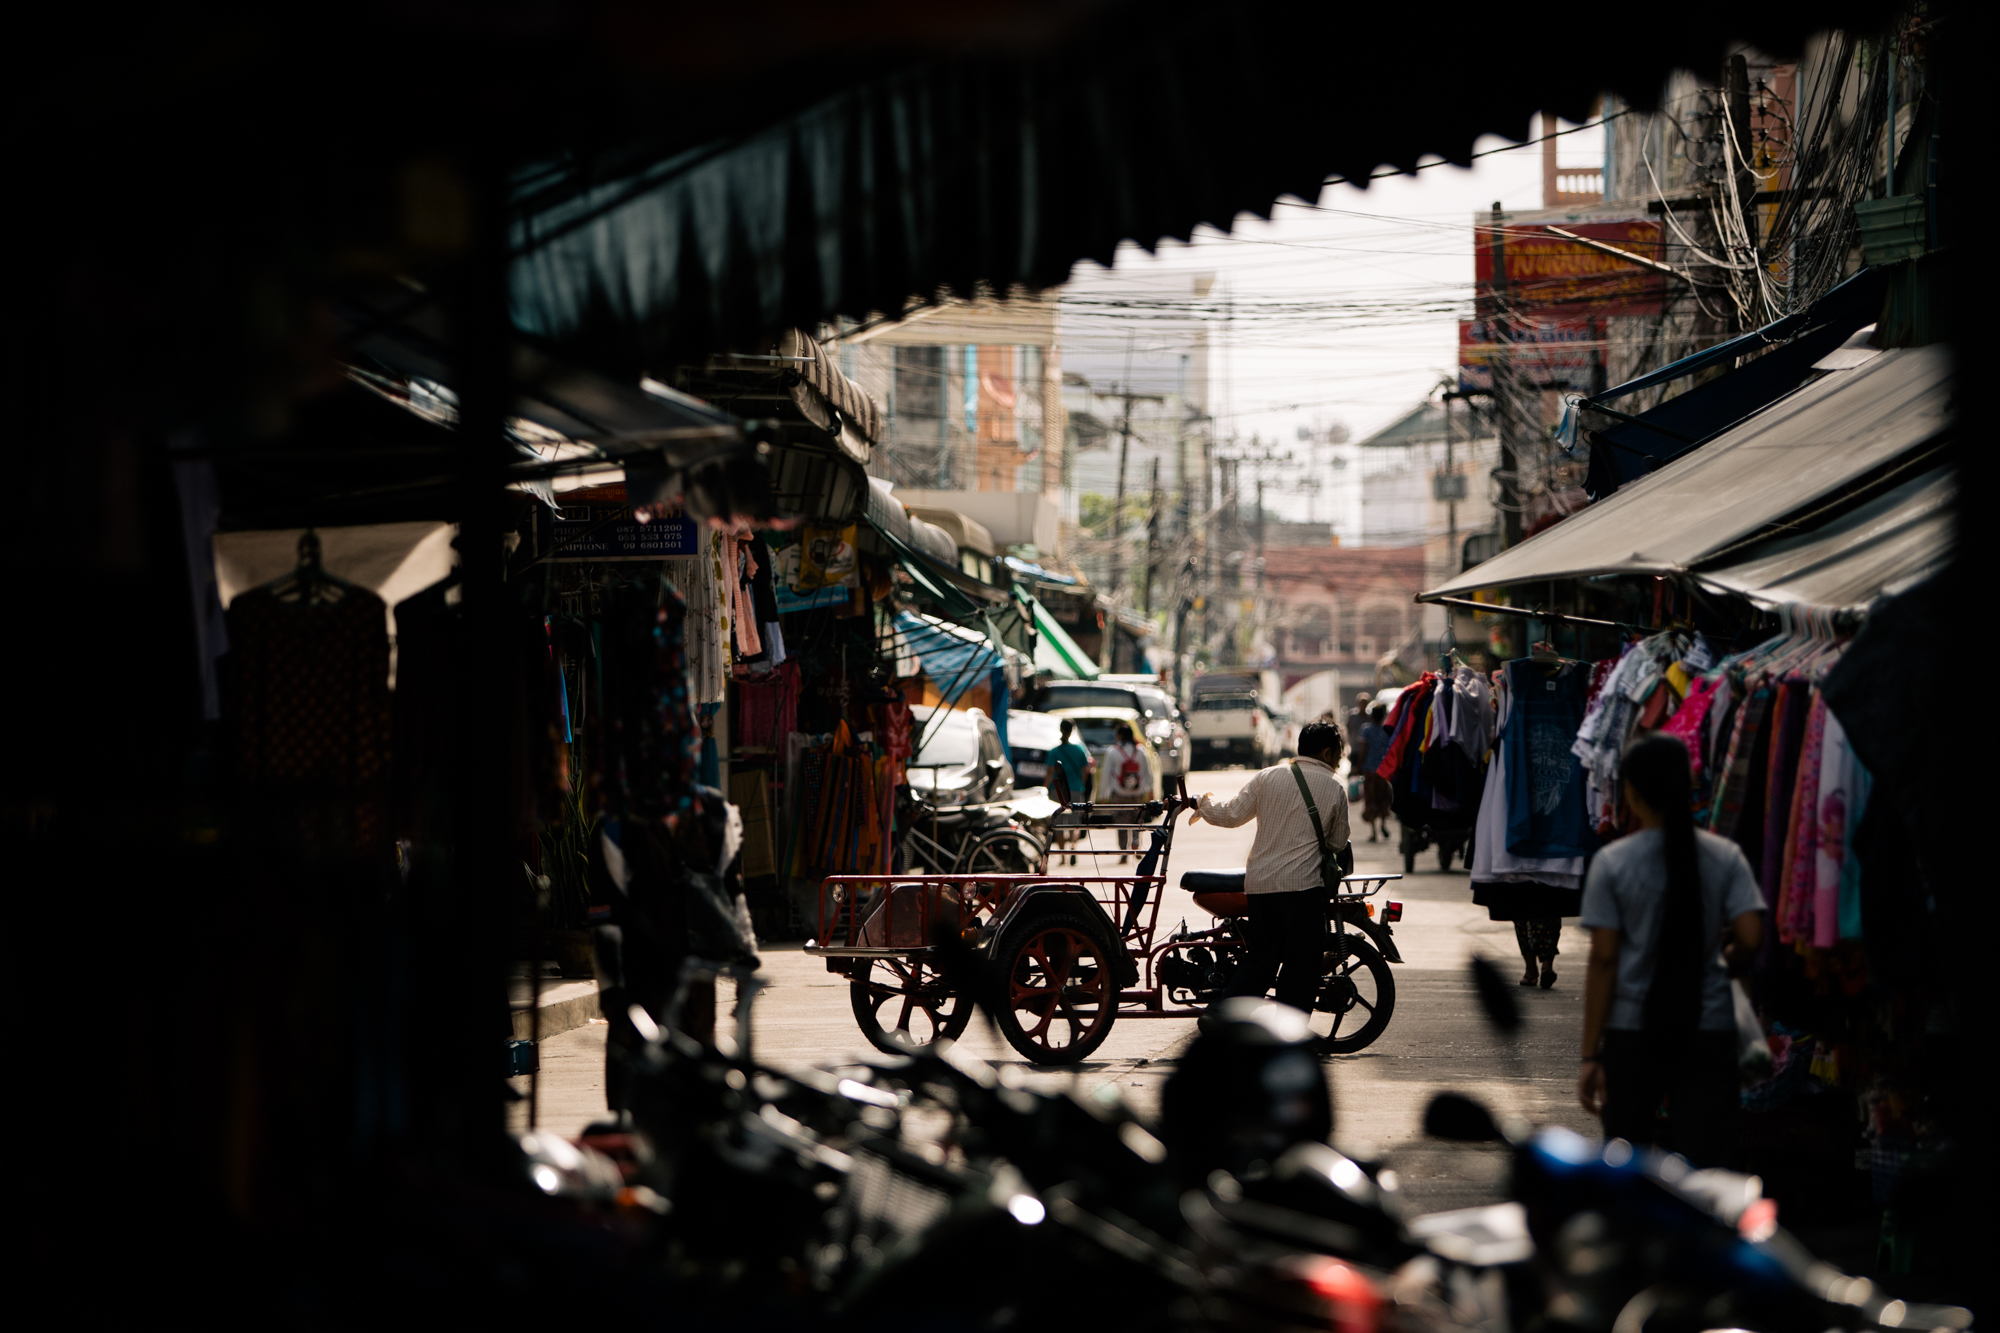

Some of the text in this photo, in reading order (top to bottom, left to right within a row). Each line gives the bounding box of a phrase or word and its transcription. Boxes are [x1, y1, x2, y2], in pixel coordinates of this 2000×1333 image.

[554, 527, 589, 536] PHON
[639, 524, 683, 533] 5711200
[554, 535, 595, 543] MOILE
[641, 533, 659, 541] 533
[664, 532, 683, 540] 075
[640, 541, 683, 549] 6801501
